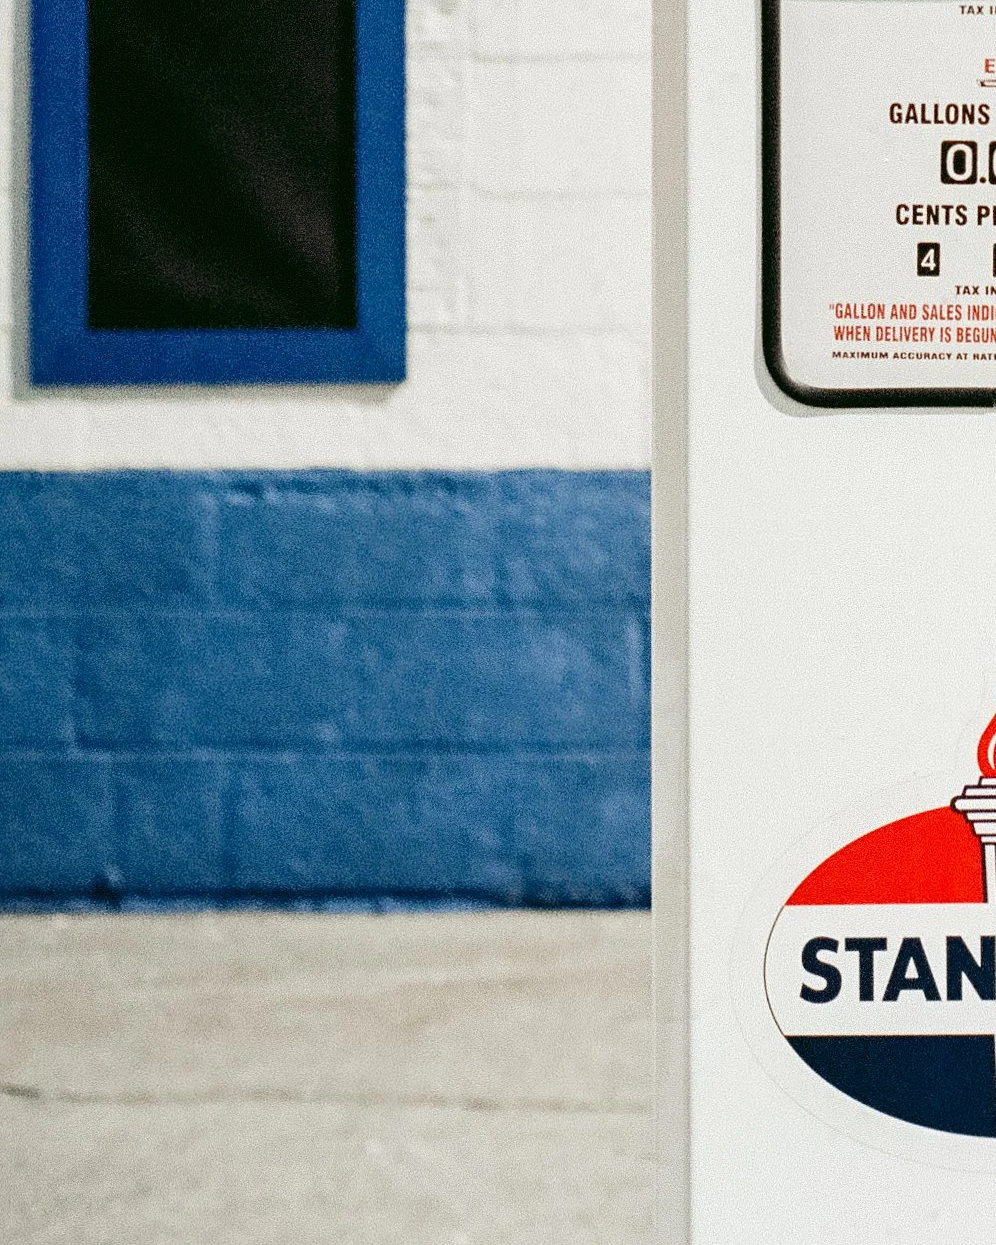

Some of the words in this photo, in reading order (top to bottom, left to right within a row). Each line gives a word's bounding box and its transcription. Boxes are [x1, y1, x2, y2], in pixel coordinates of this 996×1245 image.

[959, 5, 984, 15] TAX
[890, 103, 989, 124] GALLONS
[896, 204, 967, 225] CENTS
[920, 249, 936, 271] 4
[955, 285, 980, 295] TAX
[891, 304, 916, 319] AND
[922, 304, 962, 320] SALES
[834, 326, 870, 341] WHEN
[876, 326, 935, 342] DELIVERY
[940, 327, 951, 343] IS
[832, 351, 889, 359] MAXIMUM
[892, 352, 952, 360] ACCURACY
[955, 352, 968, 360] AT
